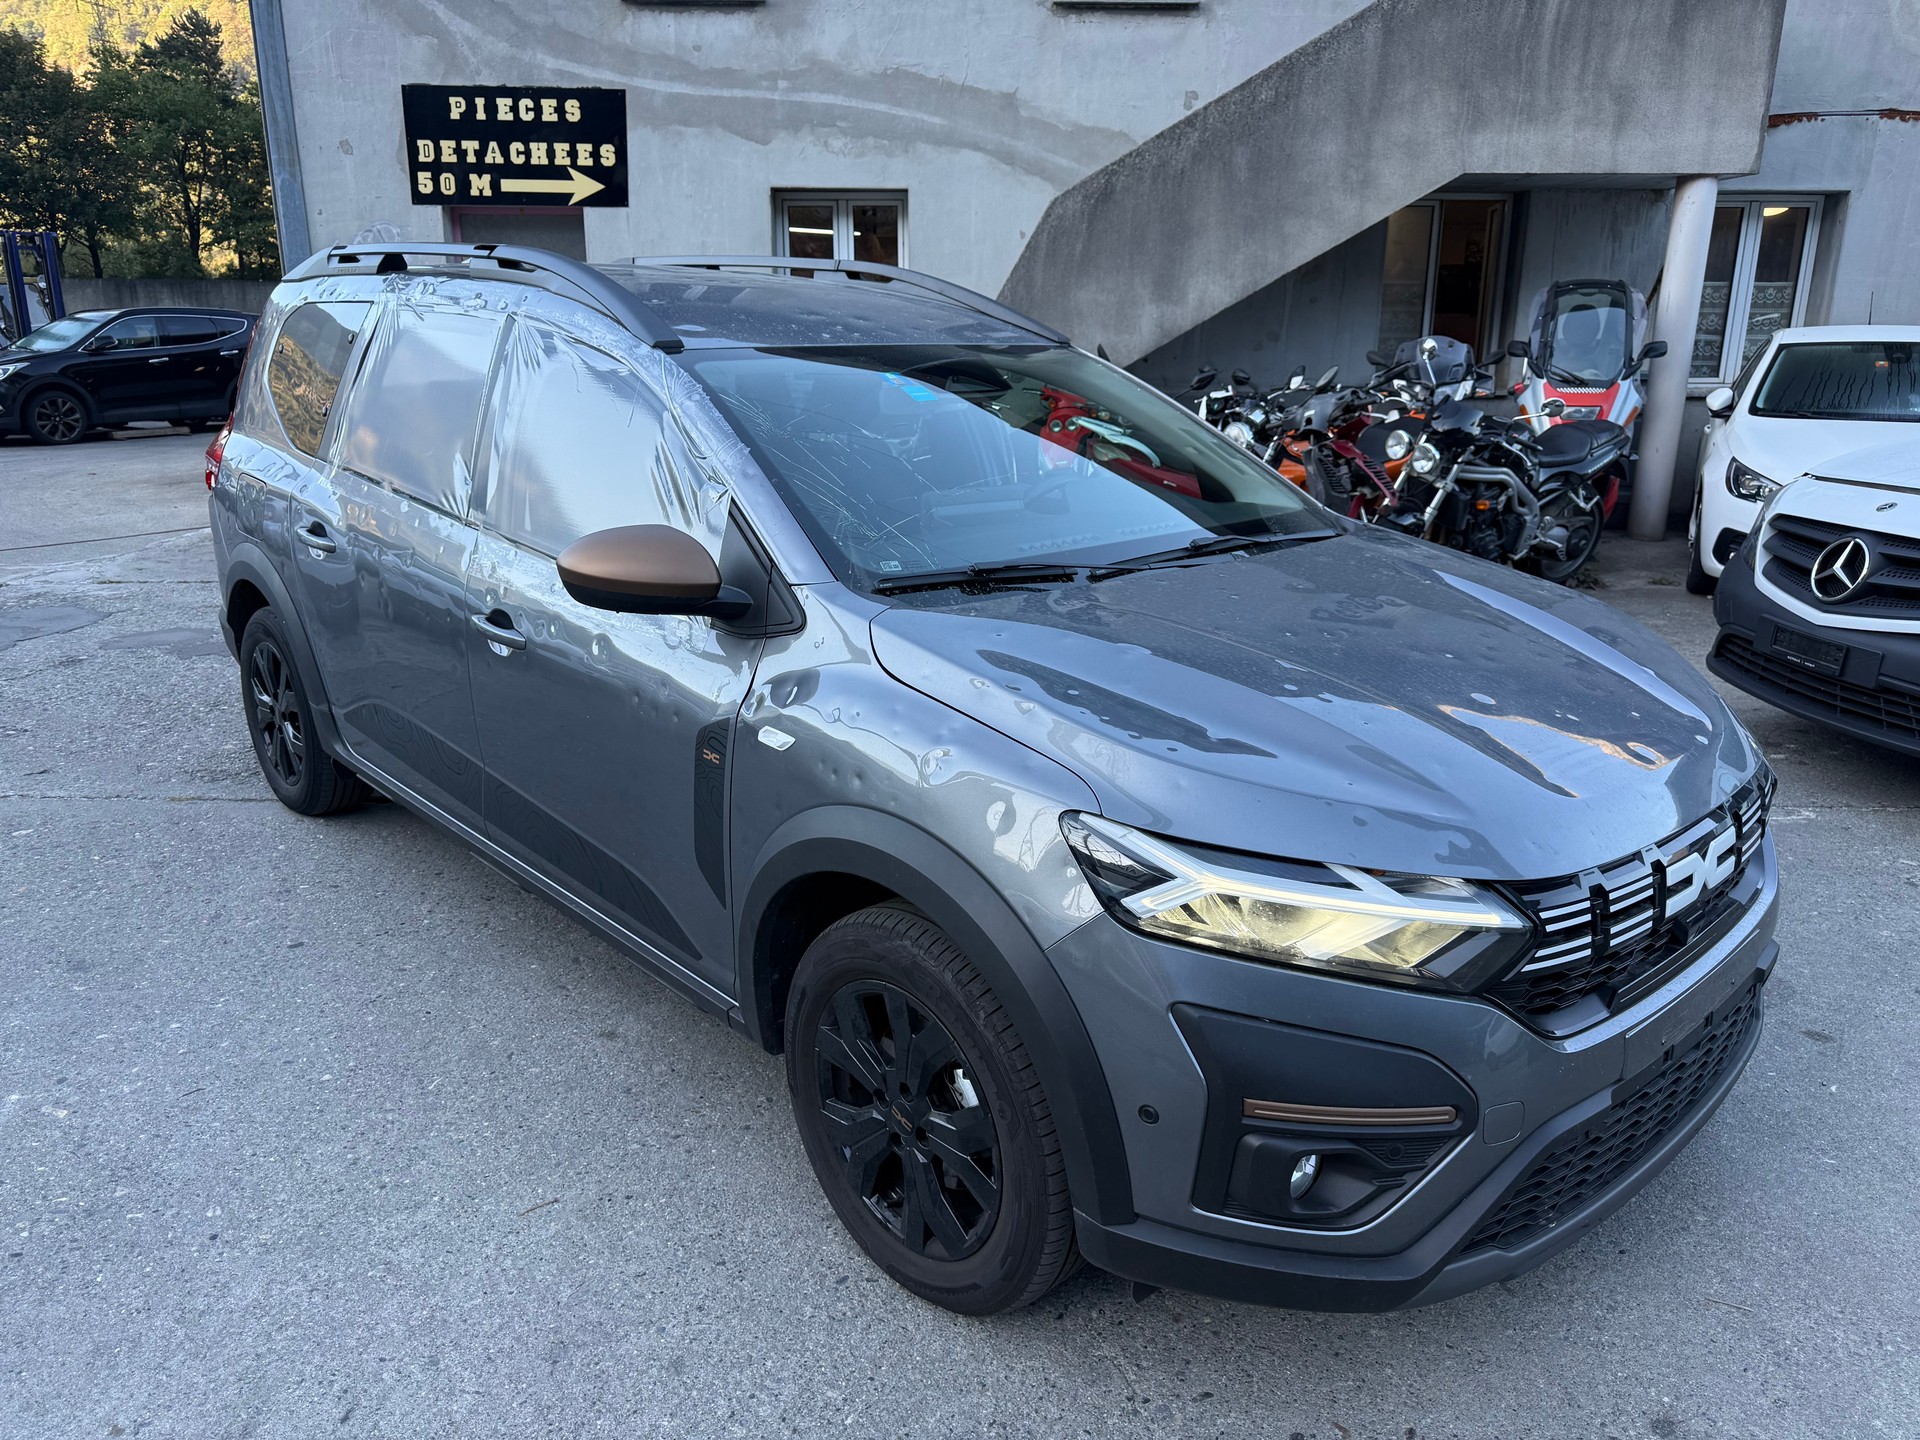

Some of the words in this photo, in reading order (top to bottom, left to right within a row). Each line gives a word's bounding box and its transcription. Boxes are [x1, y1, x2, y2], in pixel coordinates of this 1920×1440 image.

[448, 96, 582, 123] PIECES
[416, 139, 617, 167] DETACHEES
[416, 171, 456, 196] 50
[468, 173, 493, 197] M
